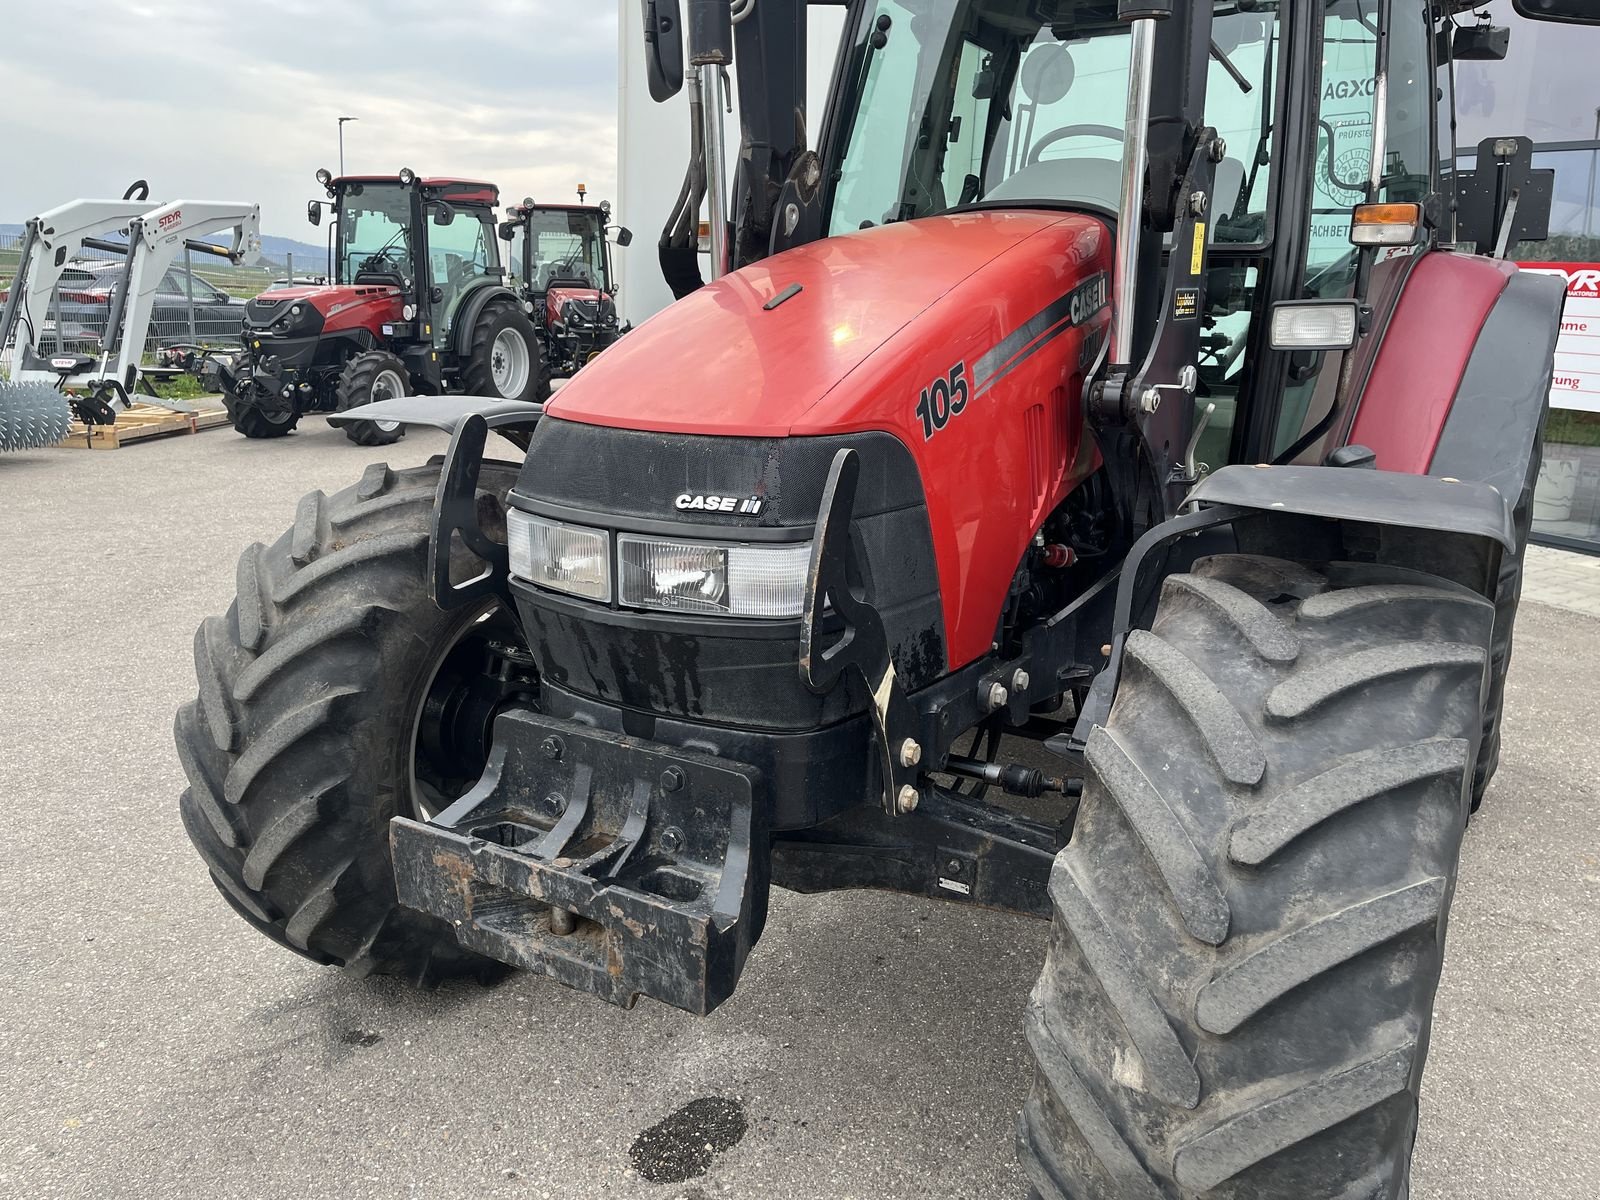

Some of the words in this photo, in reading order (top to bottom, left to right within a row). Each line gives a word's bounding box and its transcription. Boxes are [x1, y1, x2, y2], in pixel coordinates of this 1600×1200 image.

[159, 210, 181, 228] STEYR
[1070, 283, 1098, 324] CASE
[915, 360, 969, 442] 105
[675, 494, 738, 512] CASE
